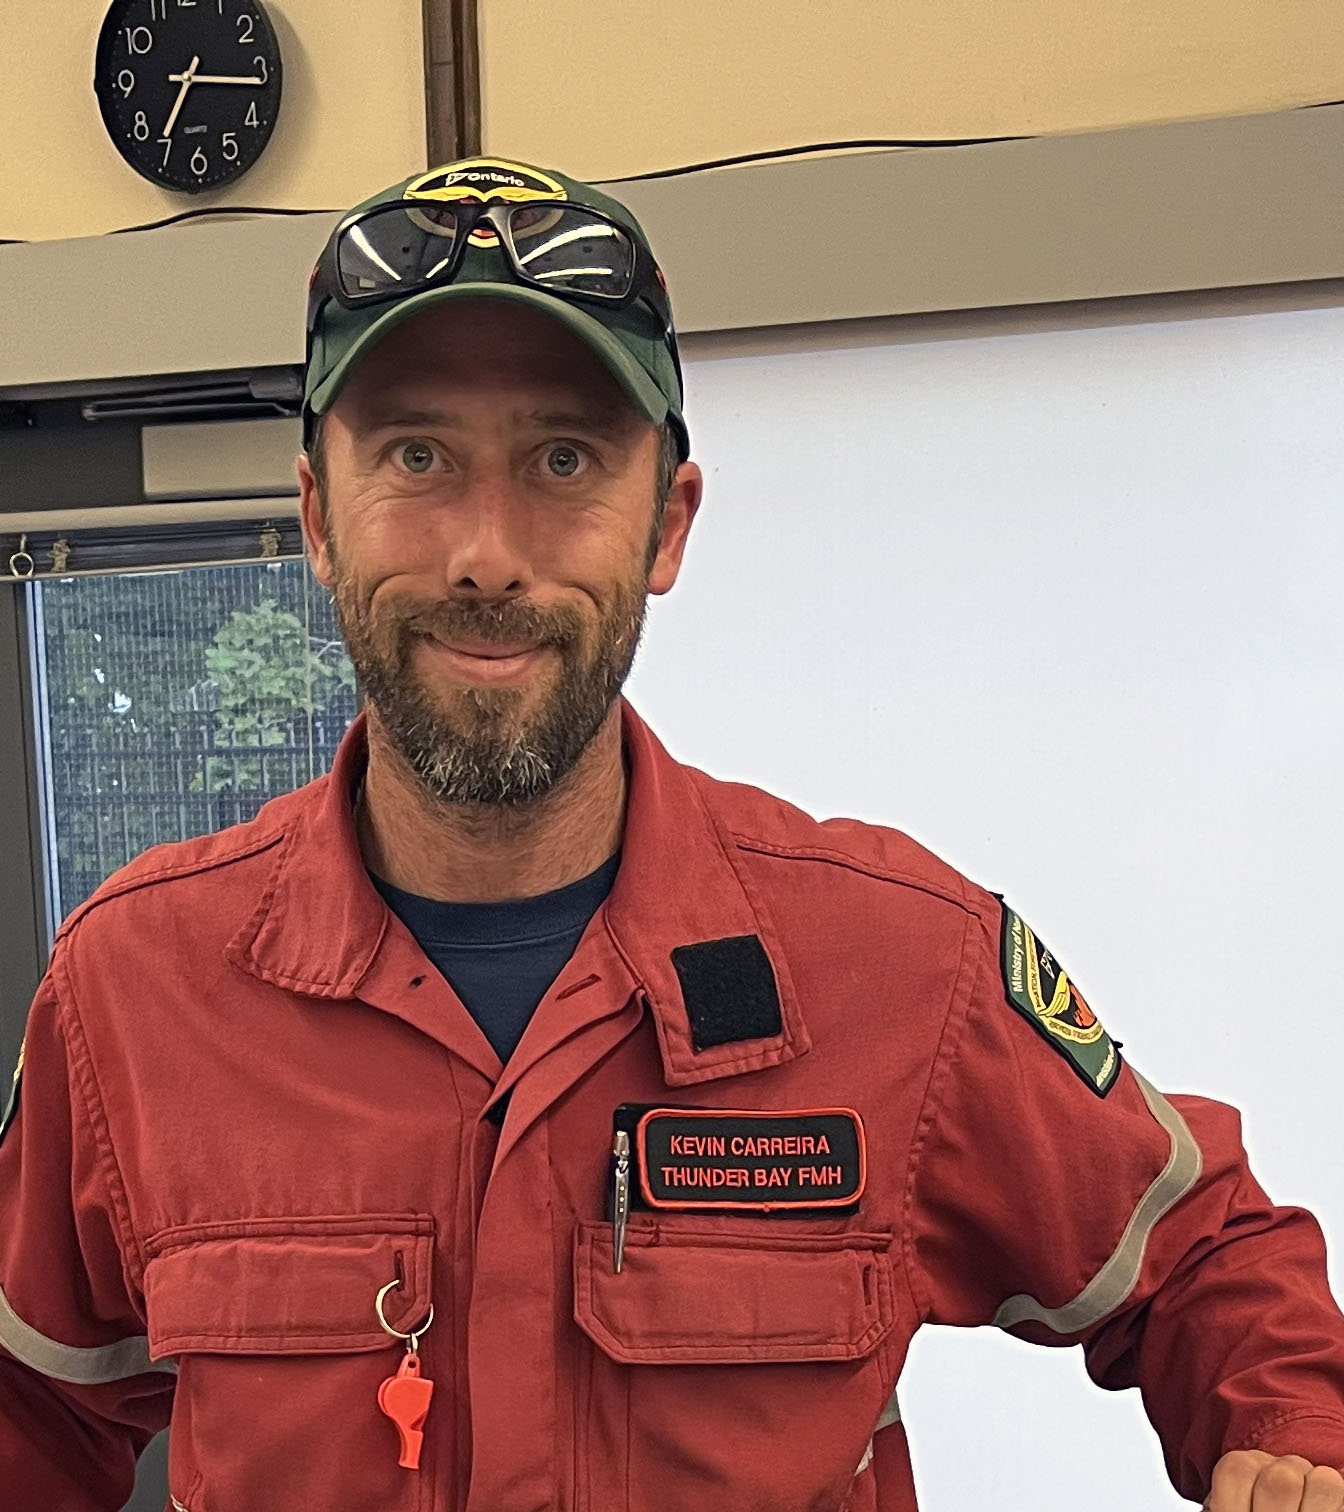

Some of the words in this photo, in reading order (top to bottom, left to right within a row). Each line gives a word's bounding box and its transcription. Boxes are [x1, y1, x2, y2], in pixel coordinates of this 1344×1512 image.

[125, 26, 153, 55] 10
[236, 14, 255, 43] 2
[117, 69, 135, 99] 9
[253, 55, 268, 84] 3
[133, 110, 150, 141] 8
[244, 101, 260, 128] 4
[156, 138, 173, 167] 7
[190, 146, 208, 175] 6
[222, 132, 239, 160] 5
[467, 171, 525, 188] Ontario
[670, 1135, 726, 1157] KEVIN
[731, 1135, 831, 1157] CARREIRA
[661, 1166, 750, 1188] THUNDER
[755, 1167, 793, 1187] BAY
[798, 1165, 843, 1186] FMH
